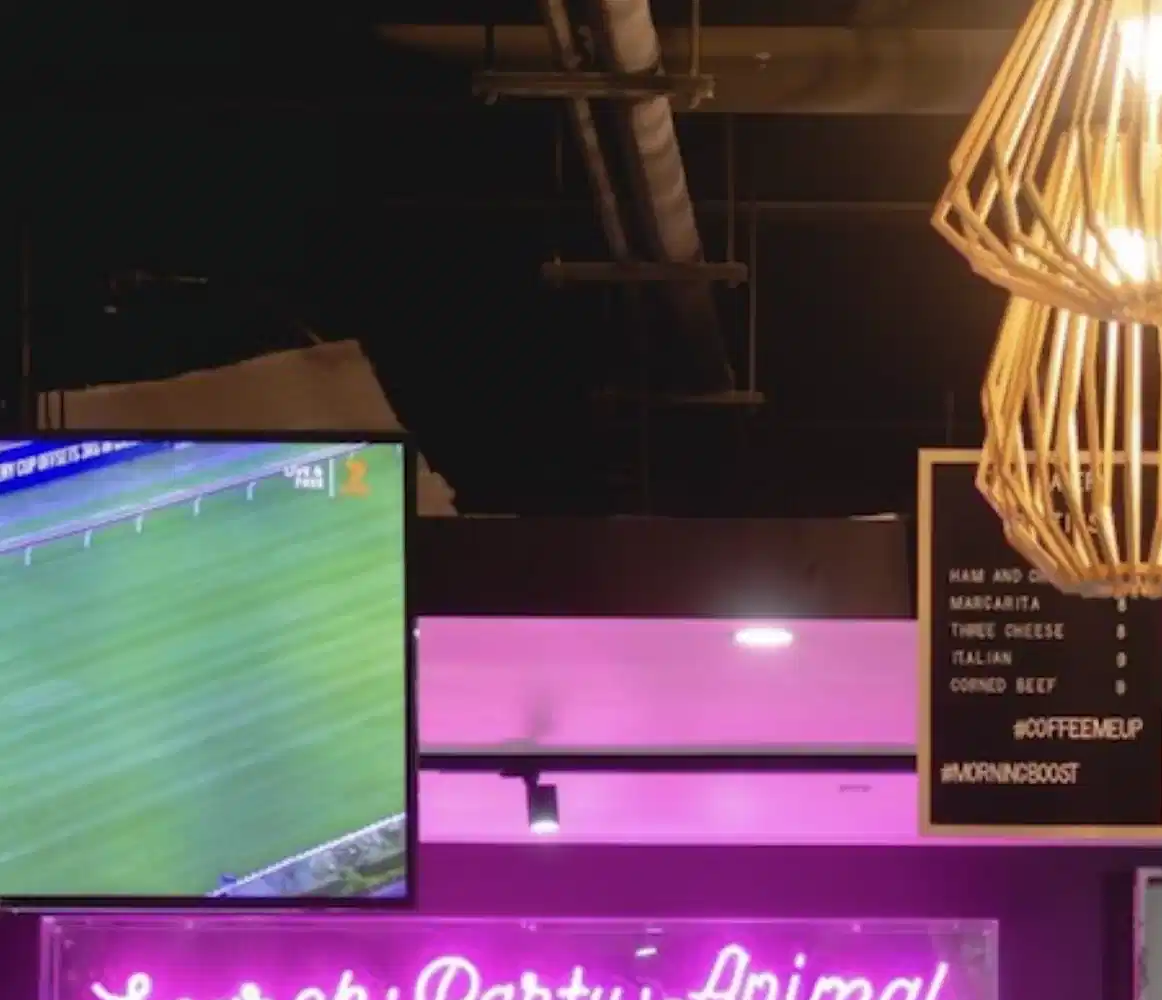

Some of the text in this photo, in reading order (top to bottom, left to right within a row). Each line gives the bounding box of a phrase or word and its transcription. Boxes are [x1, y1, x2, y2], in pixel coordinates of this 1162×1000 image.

[949, 567, 985, 584] HAM
[993, 567, 1024, 584] AND
[951, 623, 1065, 640] THREE CHEESE
[952, 650, 1012, 665] ITALIAN
[950, 677, 1057, 694] CORNED BEEF
[1013, 716, 1144, 740] #COFFEEMEUP
[940, 761, 1081, 784] #MORNINGBOOST
